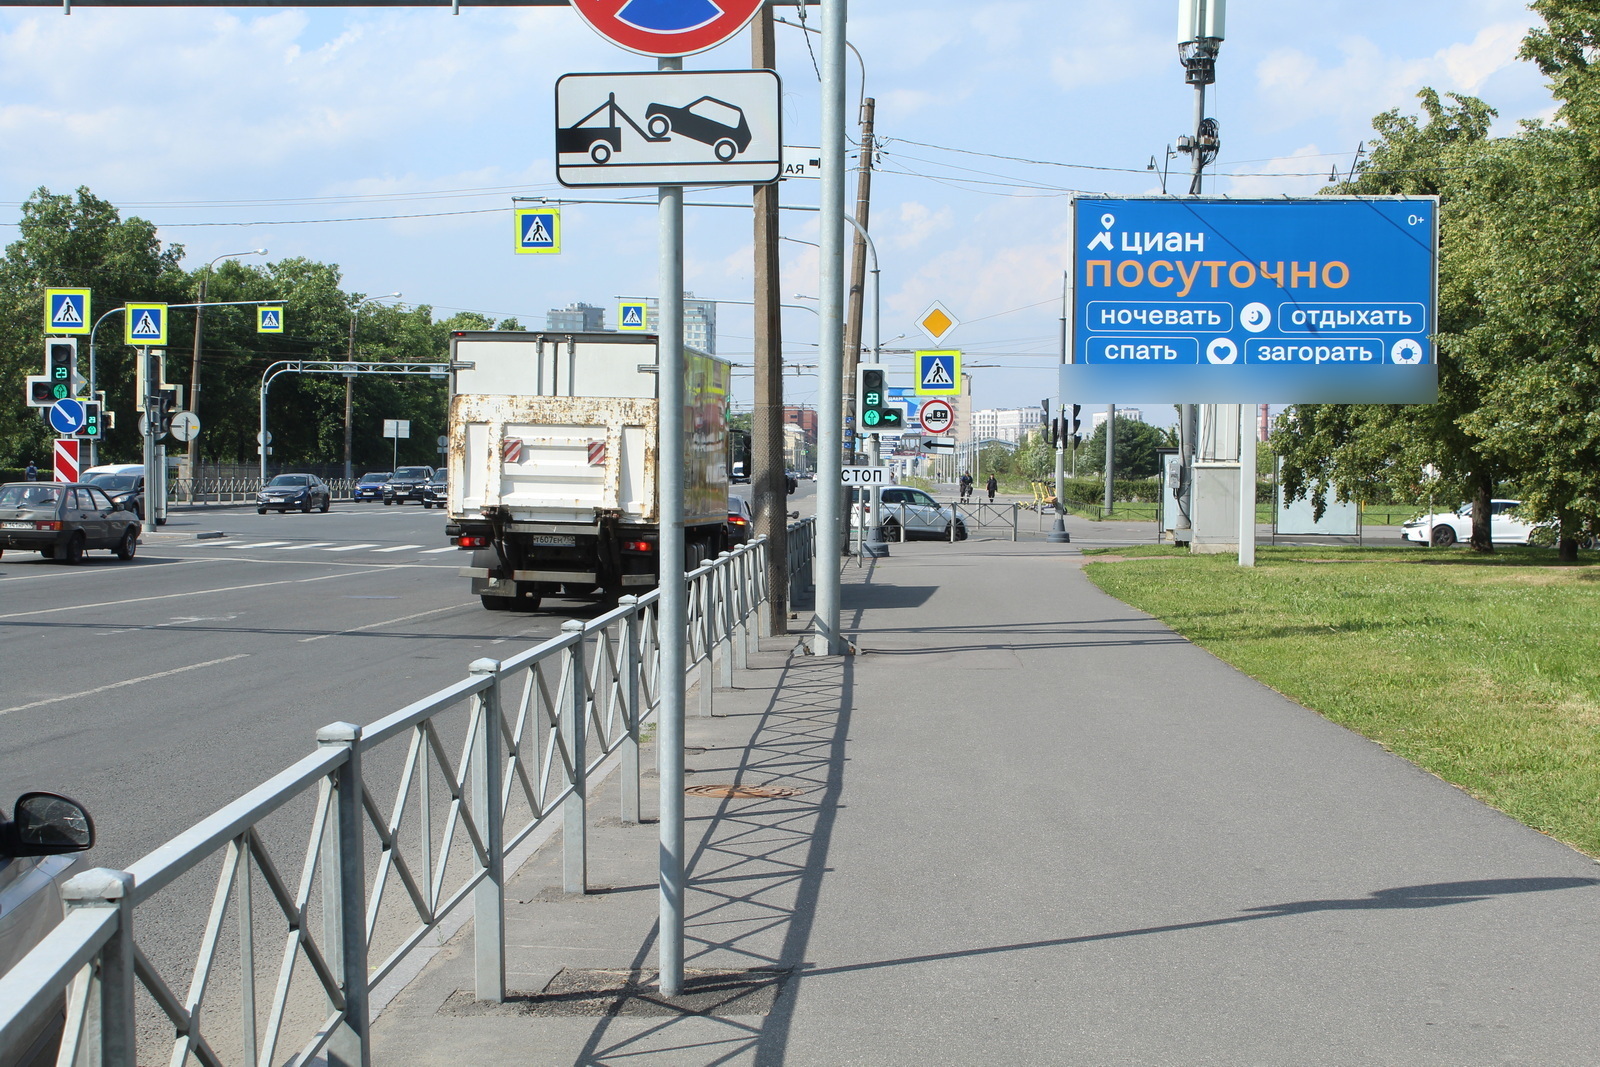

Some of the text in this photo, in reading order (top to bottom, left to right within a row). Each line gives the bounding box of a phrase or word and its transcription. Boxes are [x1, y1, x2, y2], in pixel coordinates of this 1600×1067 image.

[783, 163, 804, 174] АЯ
[1407, 214, 1425, 226] 0+
[1121, 231, 1204, 255] циан
[1086, 259, 1350, 298] посуточно
[1101, 308, 1221, 326] ночевать
[1291, 309, 1412, 329] отдыхать
[1104, 343, 1178, 360] спать
[1257, 345, 1373, 364] загорать
[55, 367, 68, 379] 23
[866, 392, 879, 405] 23
[841, 469, 882, 483] СТОП
